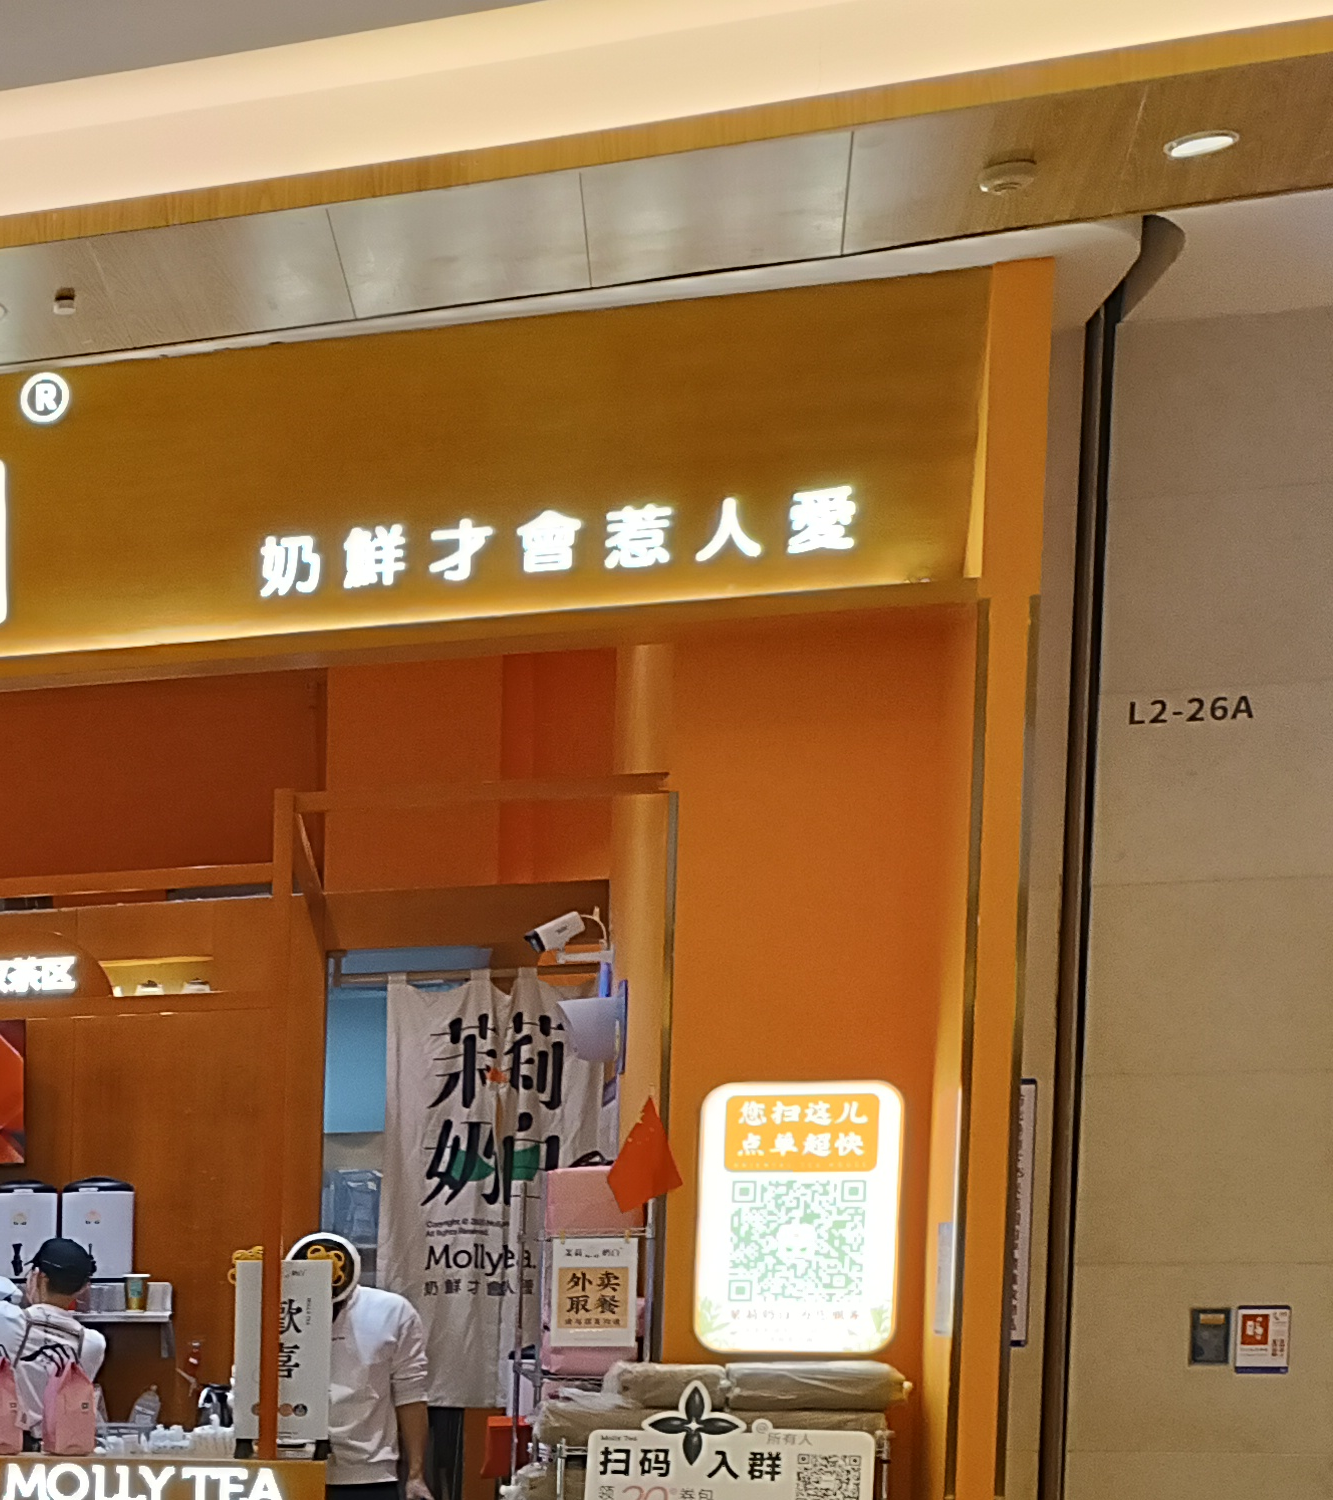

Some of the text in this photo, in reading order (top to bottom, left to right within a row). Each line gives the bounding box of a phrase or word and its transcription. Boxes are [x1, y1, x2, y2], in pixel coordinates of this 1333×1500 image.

[259, 484, 856, 598] 奶鮮才會惹人愛
[1128, 695, 1255, 725] L2-26A
[426, 1011, 566, 1111] 茉莉
[738, 1100, 869, 1127] 您扫这儿
[420, 1112, 561, 1207] 奶白
[737, 1132, 866, 1158] 点单超快
[566, 1270, 621, 1292] 外卖
[566, 1293, 621, 1315] 取餐
[599, 1447, 782, 1482] 扫码 入群
